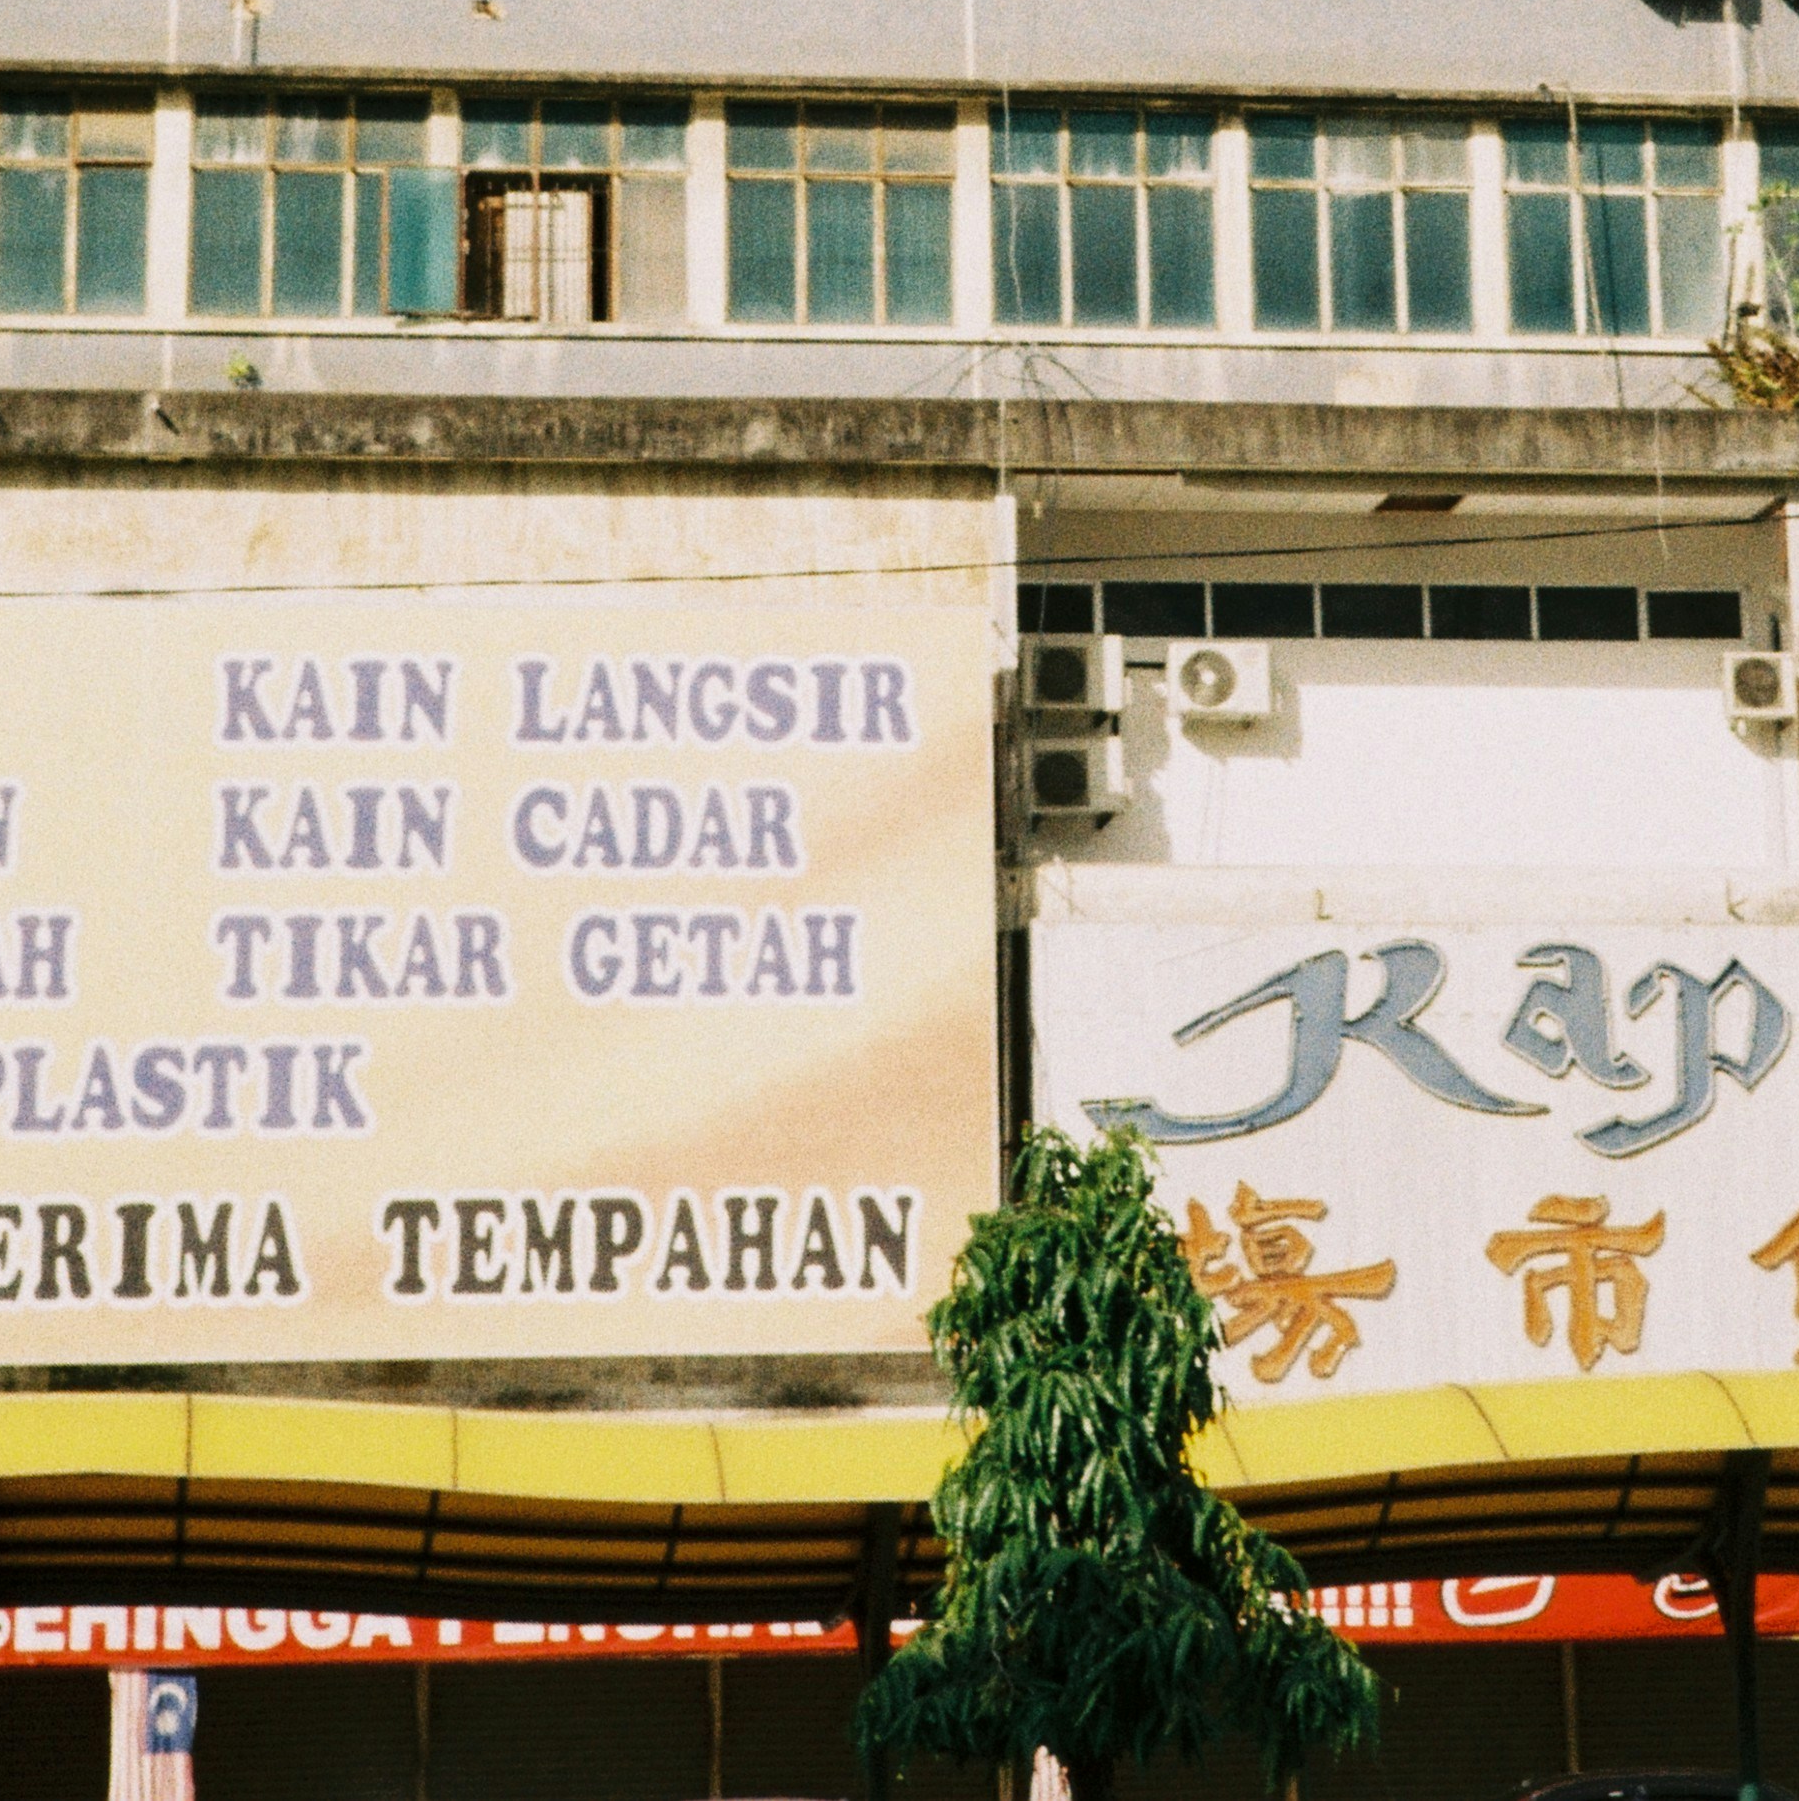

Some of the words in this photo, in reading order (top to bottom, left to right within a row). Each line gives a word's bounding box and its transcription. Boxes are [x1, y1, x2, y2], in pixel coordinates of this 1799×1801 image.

[222, 660, 452, 741] KAIN
[516, 661, 911, 743] LANGSIR
[219, 787, 450, 870] KAIN
[514, 787, 797, 869] CADAR
[217, 915, 506, 999] TIKAR
[570, 914, 855, 997] GETAH
[383, 1196, 912, 1295] TEMPAHAN
